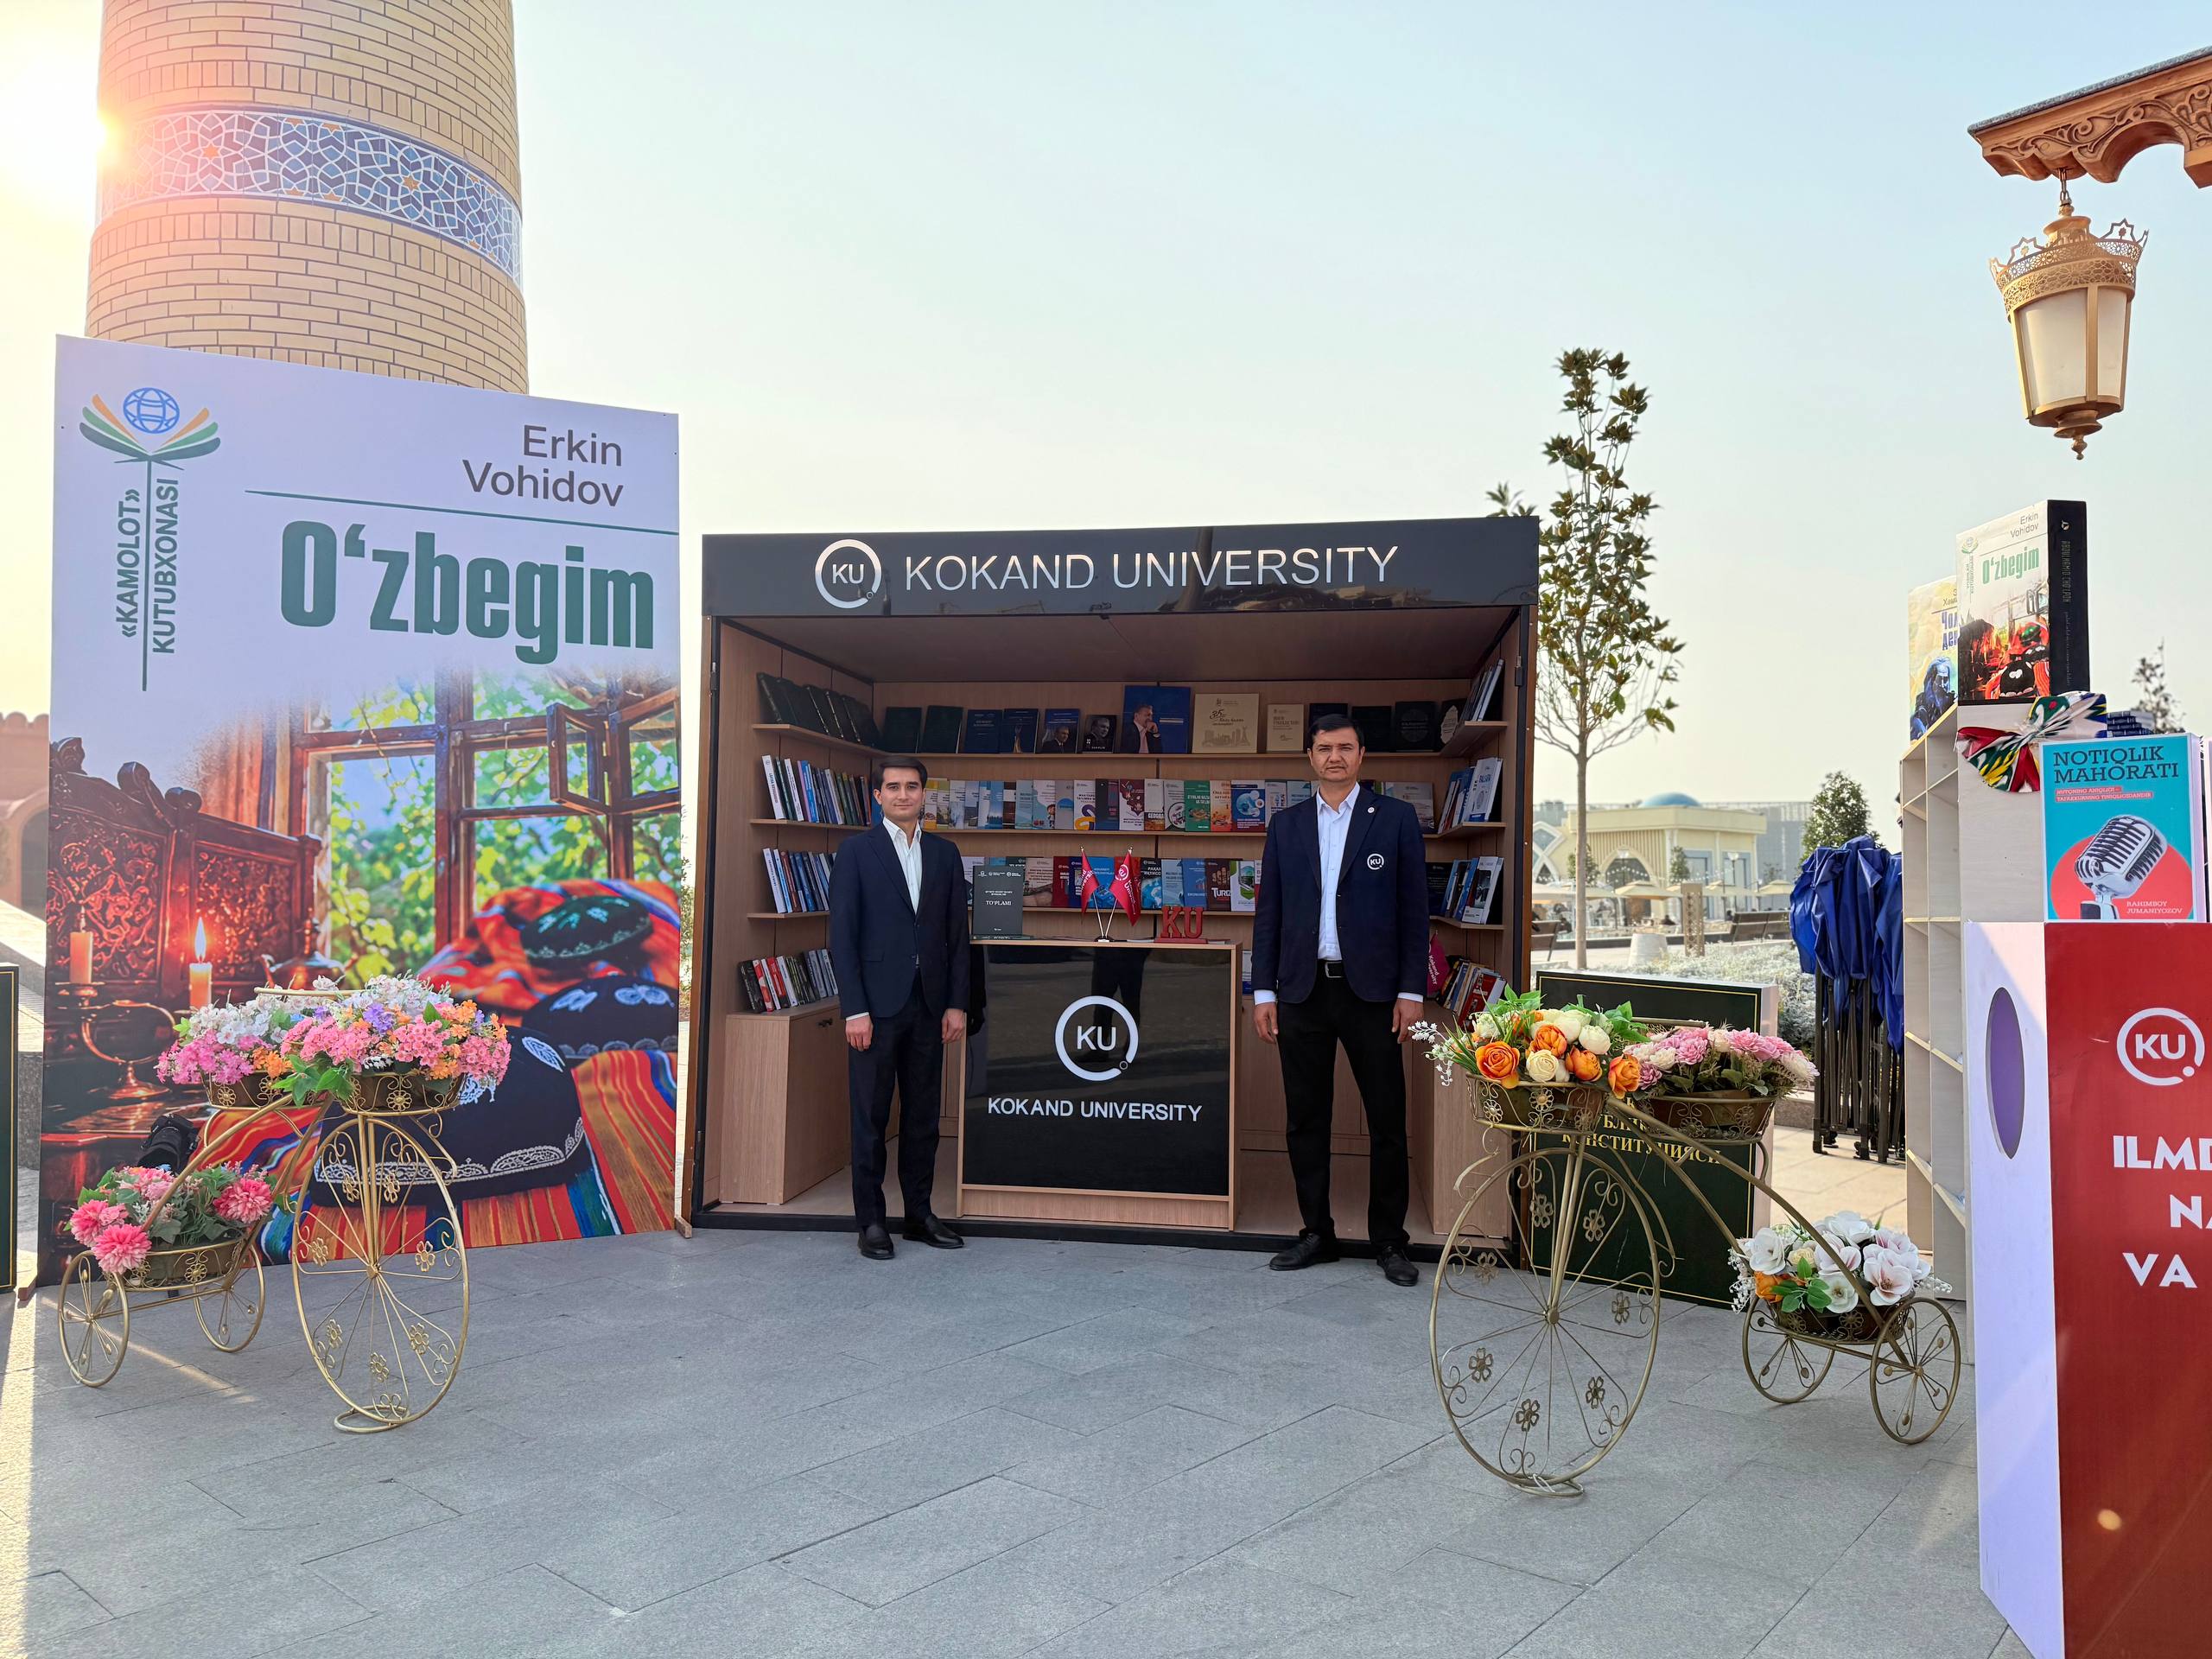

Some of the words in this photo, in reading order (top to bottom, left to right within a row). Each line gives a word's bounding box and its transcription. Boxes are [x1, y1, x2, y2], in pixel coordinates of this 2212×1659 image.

[523, 424, 623, 467] Erkin
[461, 459, 625, 507] Vohidov
[2010, 523, 2039, 538] Vohidov
[2019, 512, 2039, 525] Erkin
[115, 487, 141, 639] «KAMOLOT»
[152, 477, 181, 654] KUTUBXONASI
[831, 563, 865, 584] KU
[906, 553, 1095, 590] KOKAND
[1112, 545, 1399, 588] UNIVERSITY
[1981, 546, 2040, 585] O‘zbegim
[279, 519, 654, 665] O‘zbegim
[2052, 745, 2165, 767] NOTIQLIK
[2054, 762, 2180, 785] MAHORATI
[1160, 906, 1204, 938] KU
[1077, 1025, 1116, 1051] KU
[2134, 1033, 2186, 1060] KU
[988, 1096, 1073, 1117] KOKAND
[1080, 1101, 1203, 1122] UNIVERSITY
[1561, 1133, 1722, 1165] КНСТИТУЦИЯСИ
[2170, 1193, 2212, 1230] N
[2122, 1252, 2198, 1288] VA
